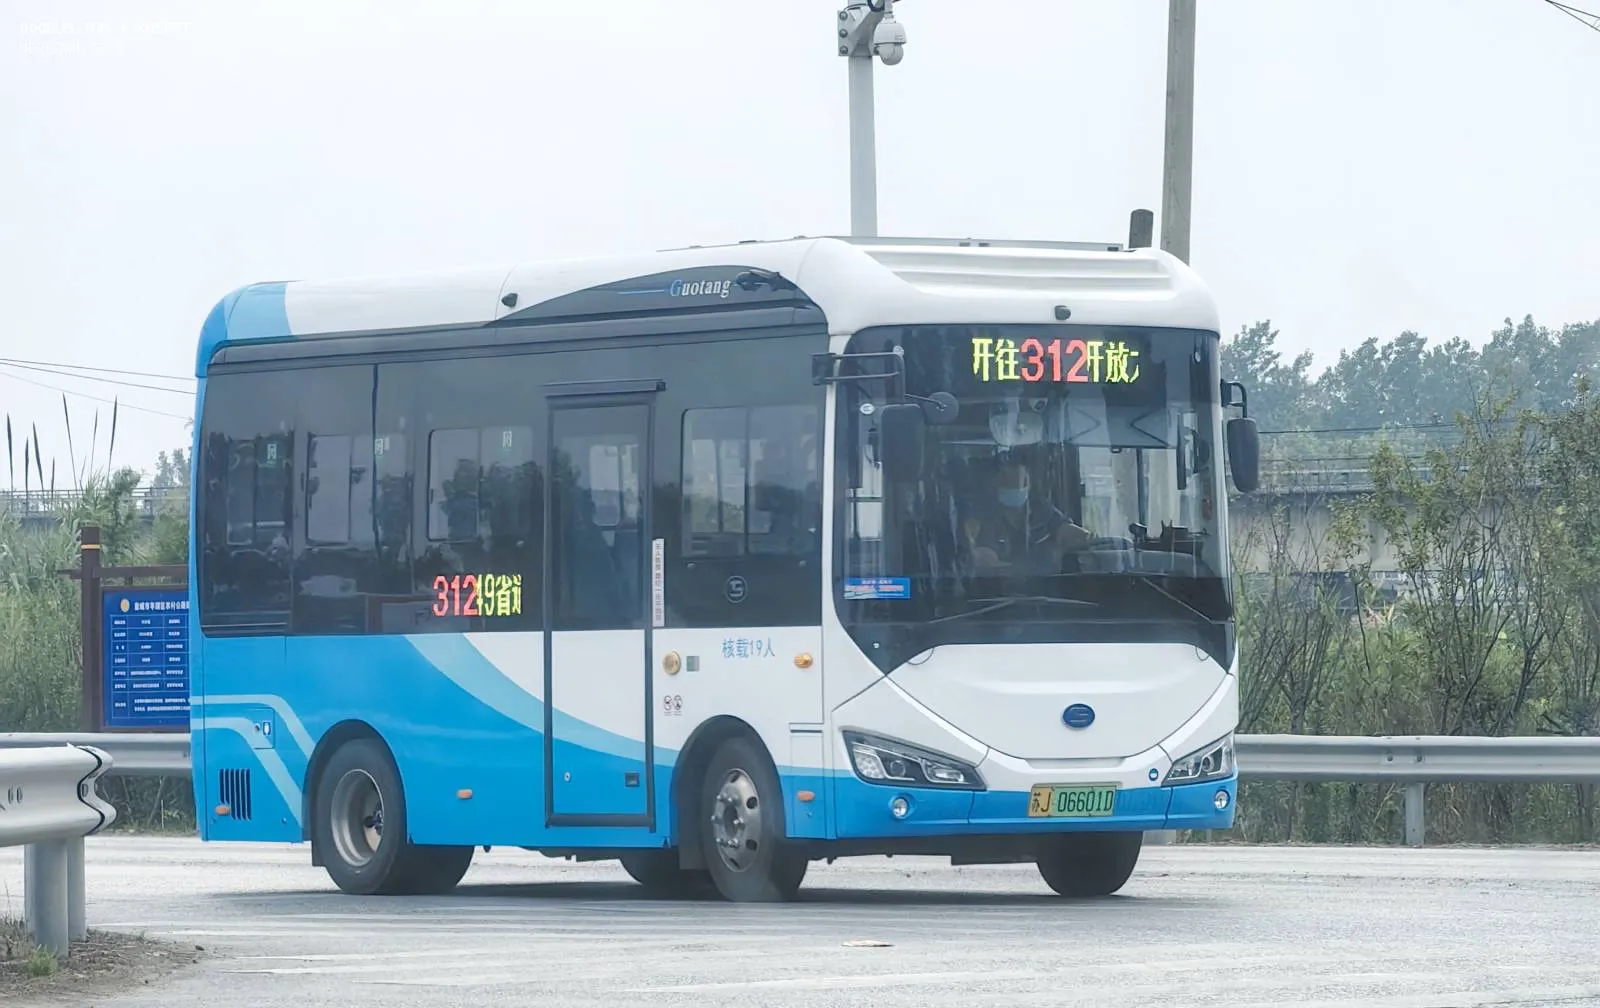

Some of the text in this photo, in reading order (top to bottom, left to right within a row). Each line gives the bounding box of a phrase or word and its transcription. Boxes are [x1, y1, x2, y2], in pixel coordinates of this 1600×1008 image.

[670, 279, 731, 298] Guotang
[721, 637, 775, 659] 核载19人
